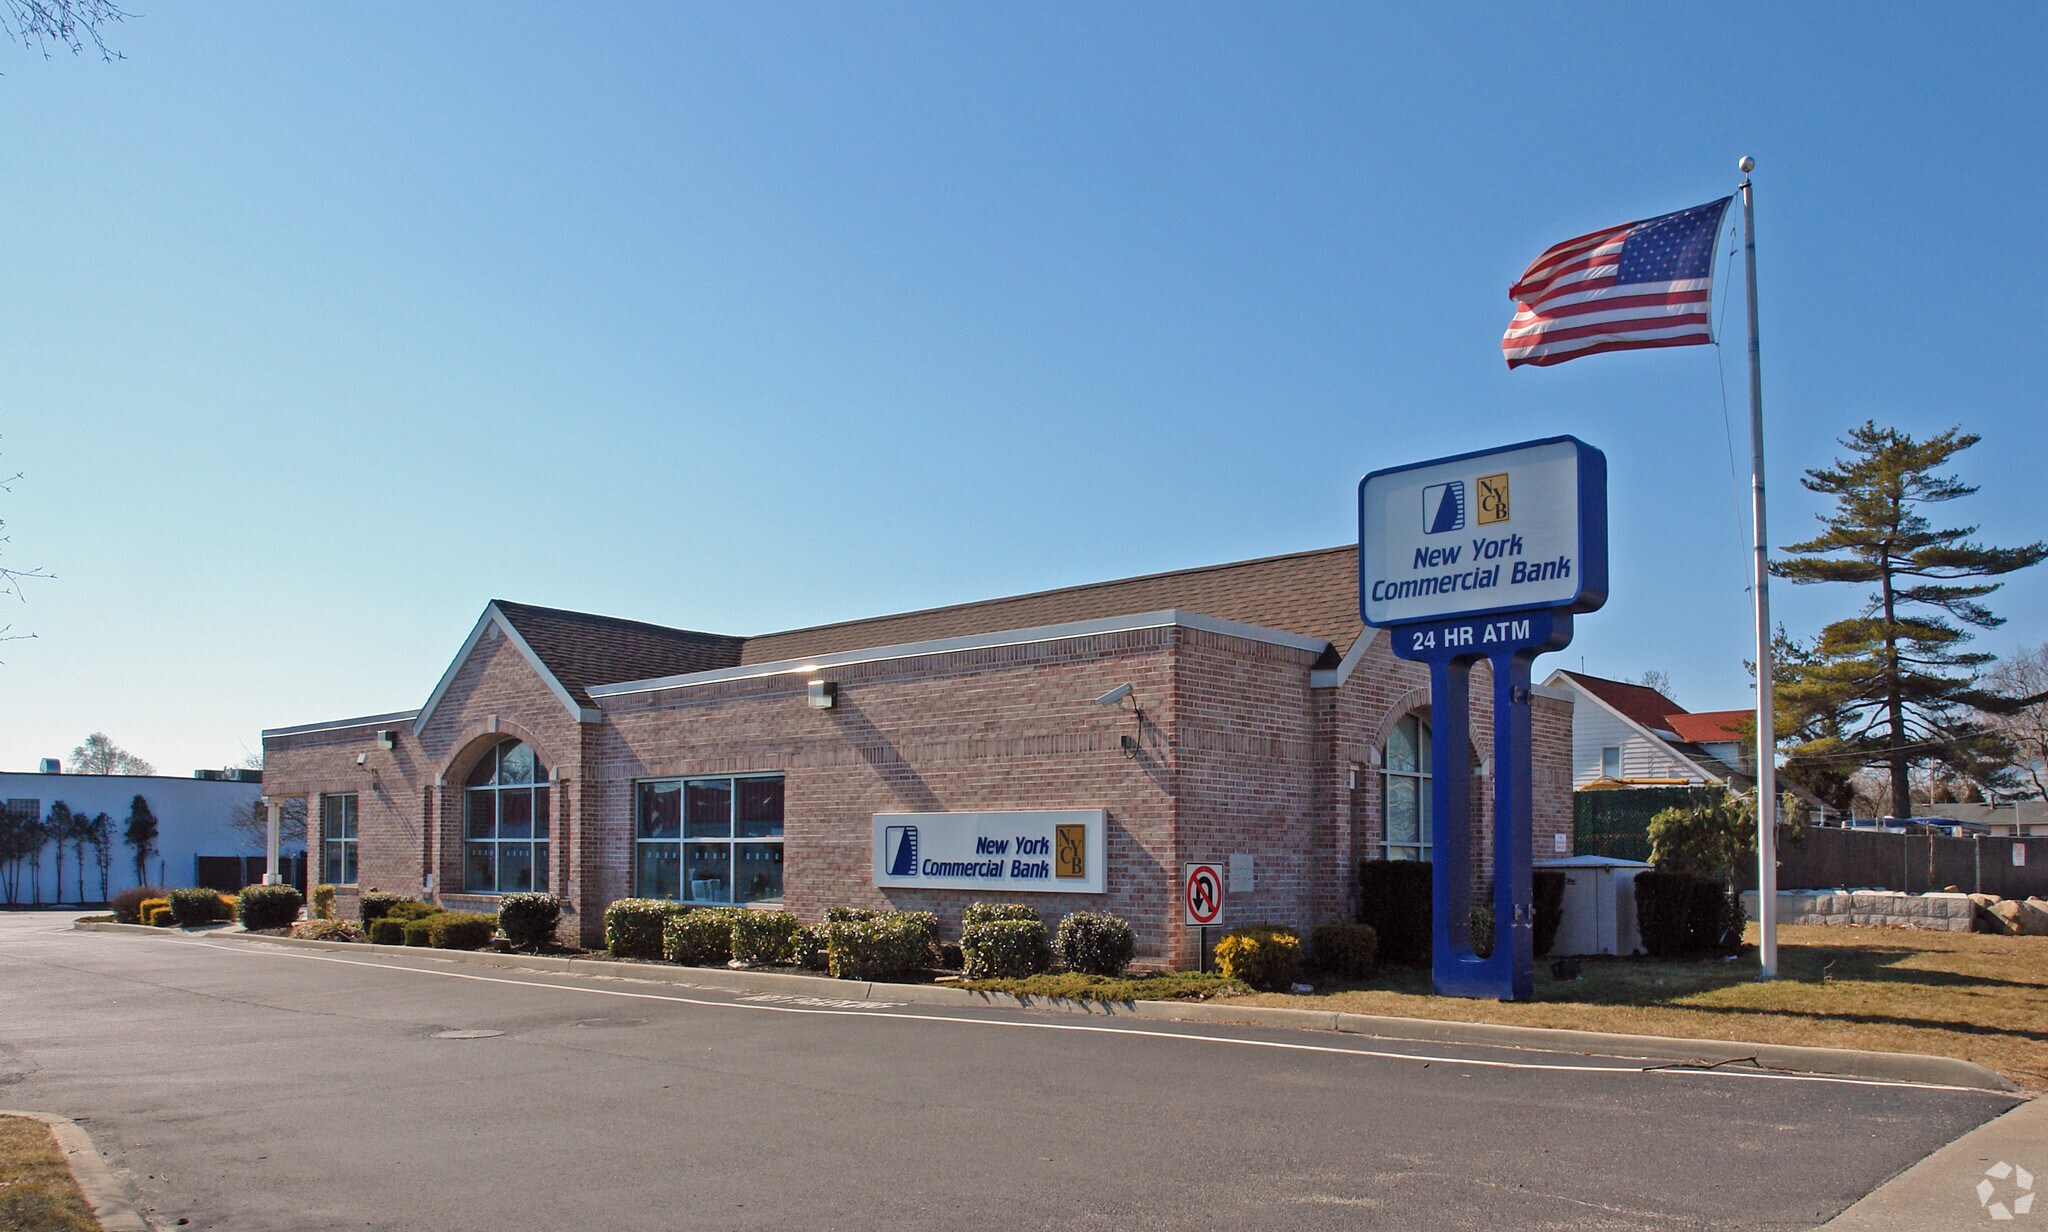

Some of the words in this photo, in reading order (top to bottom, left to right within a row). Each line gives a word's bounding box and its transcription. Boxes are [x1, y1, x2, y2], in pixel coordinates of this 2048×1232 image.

[1413, 545, 1462, 569] New
[1472, 533, 1523, 561] York
[1372, 565, 1500, 602] Commercial
[1510, 556, 1571, 584] Bank
[1412, 631, 1436, 650] 24
[1444, 627, 1474, 648] HR
[1482, 619, 1530, 643] ATM
[975, 836, 1009, 854] New
[1015, 836, 1049, 854] York
[922, 859, 1004, 877] Commercial
[1010, 860, 1049, 878] Bank
